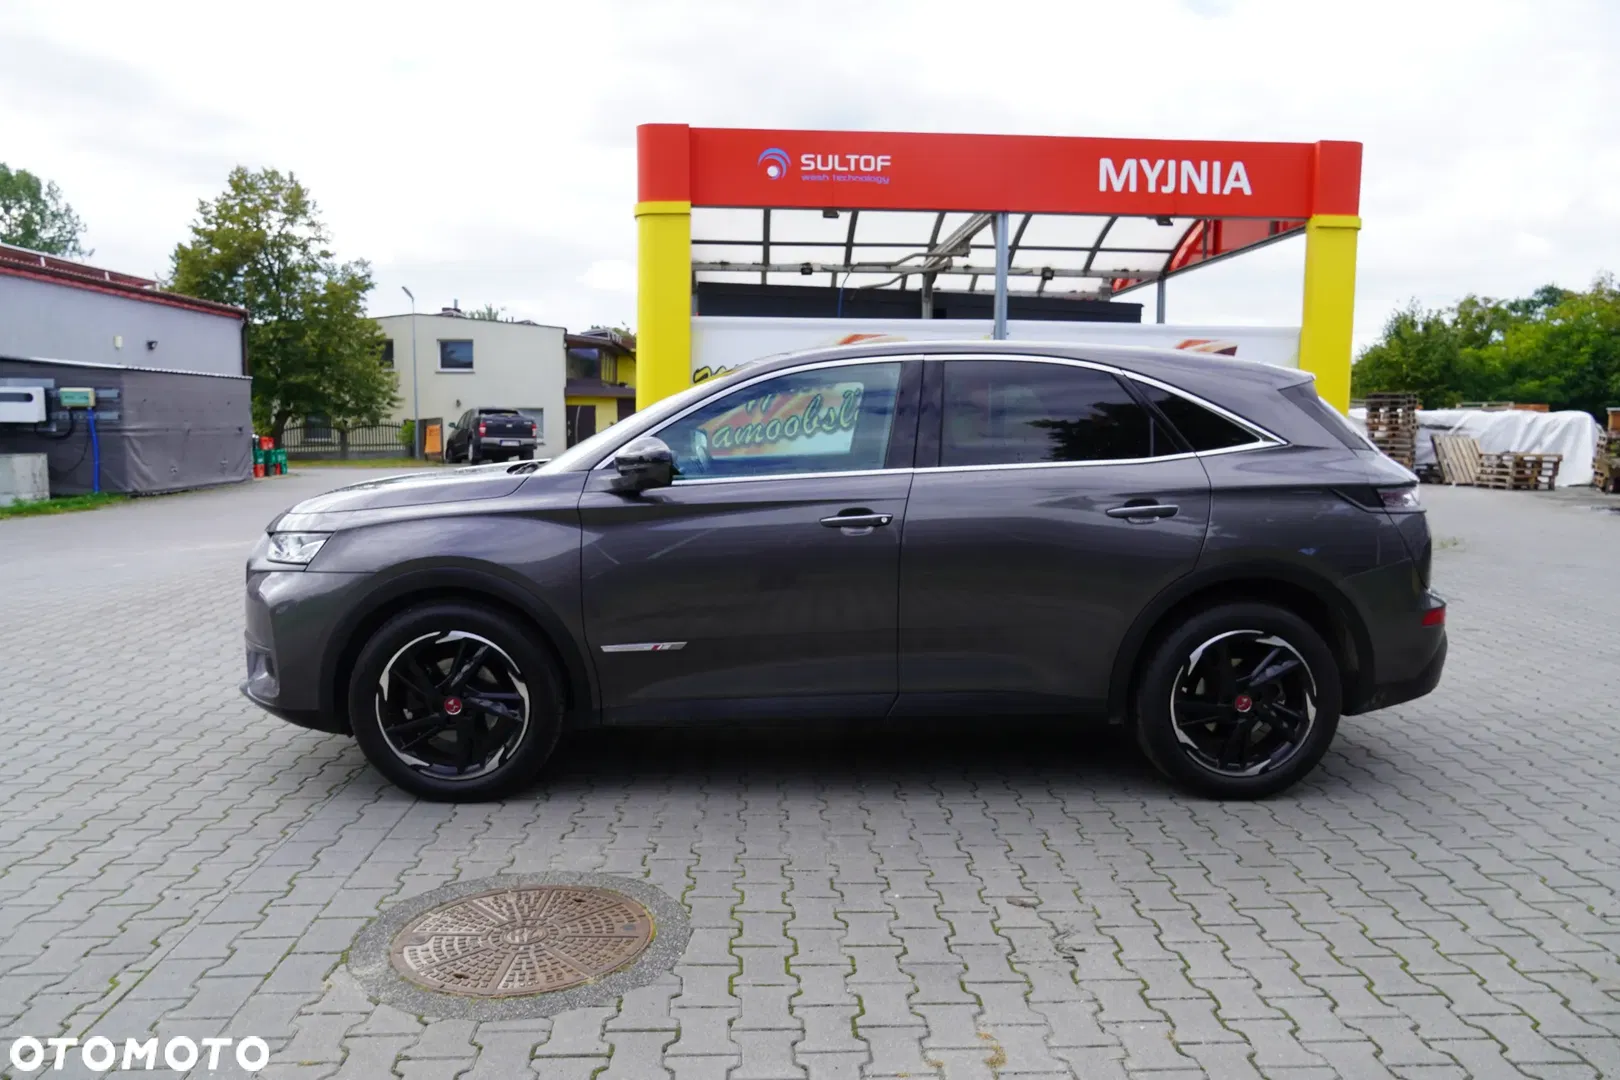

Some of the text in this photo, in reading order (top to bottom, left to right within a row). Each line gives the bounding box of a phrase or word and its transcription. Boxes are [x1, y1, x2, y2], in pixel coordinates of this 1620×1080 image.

[800, 153, 892, 172] SULTOF
[801, 173, 890, 185] wash technology
[1099, 157, 1253, 196] MYJNIA
